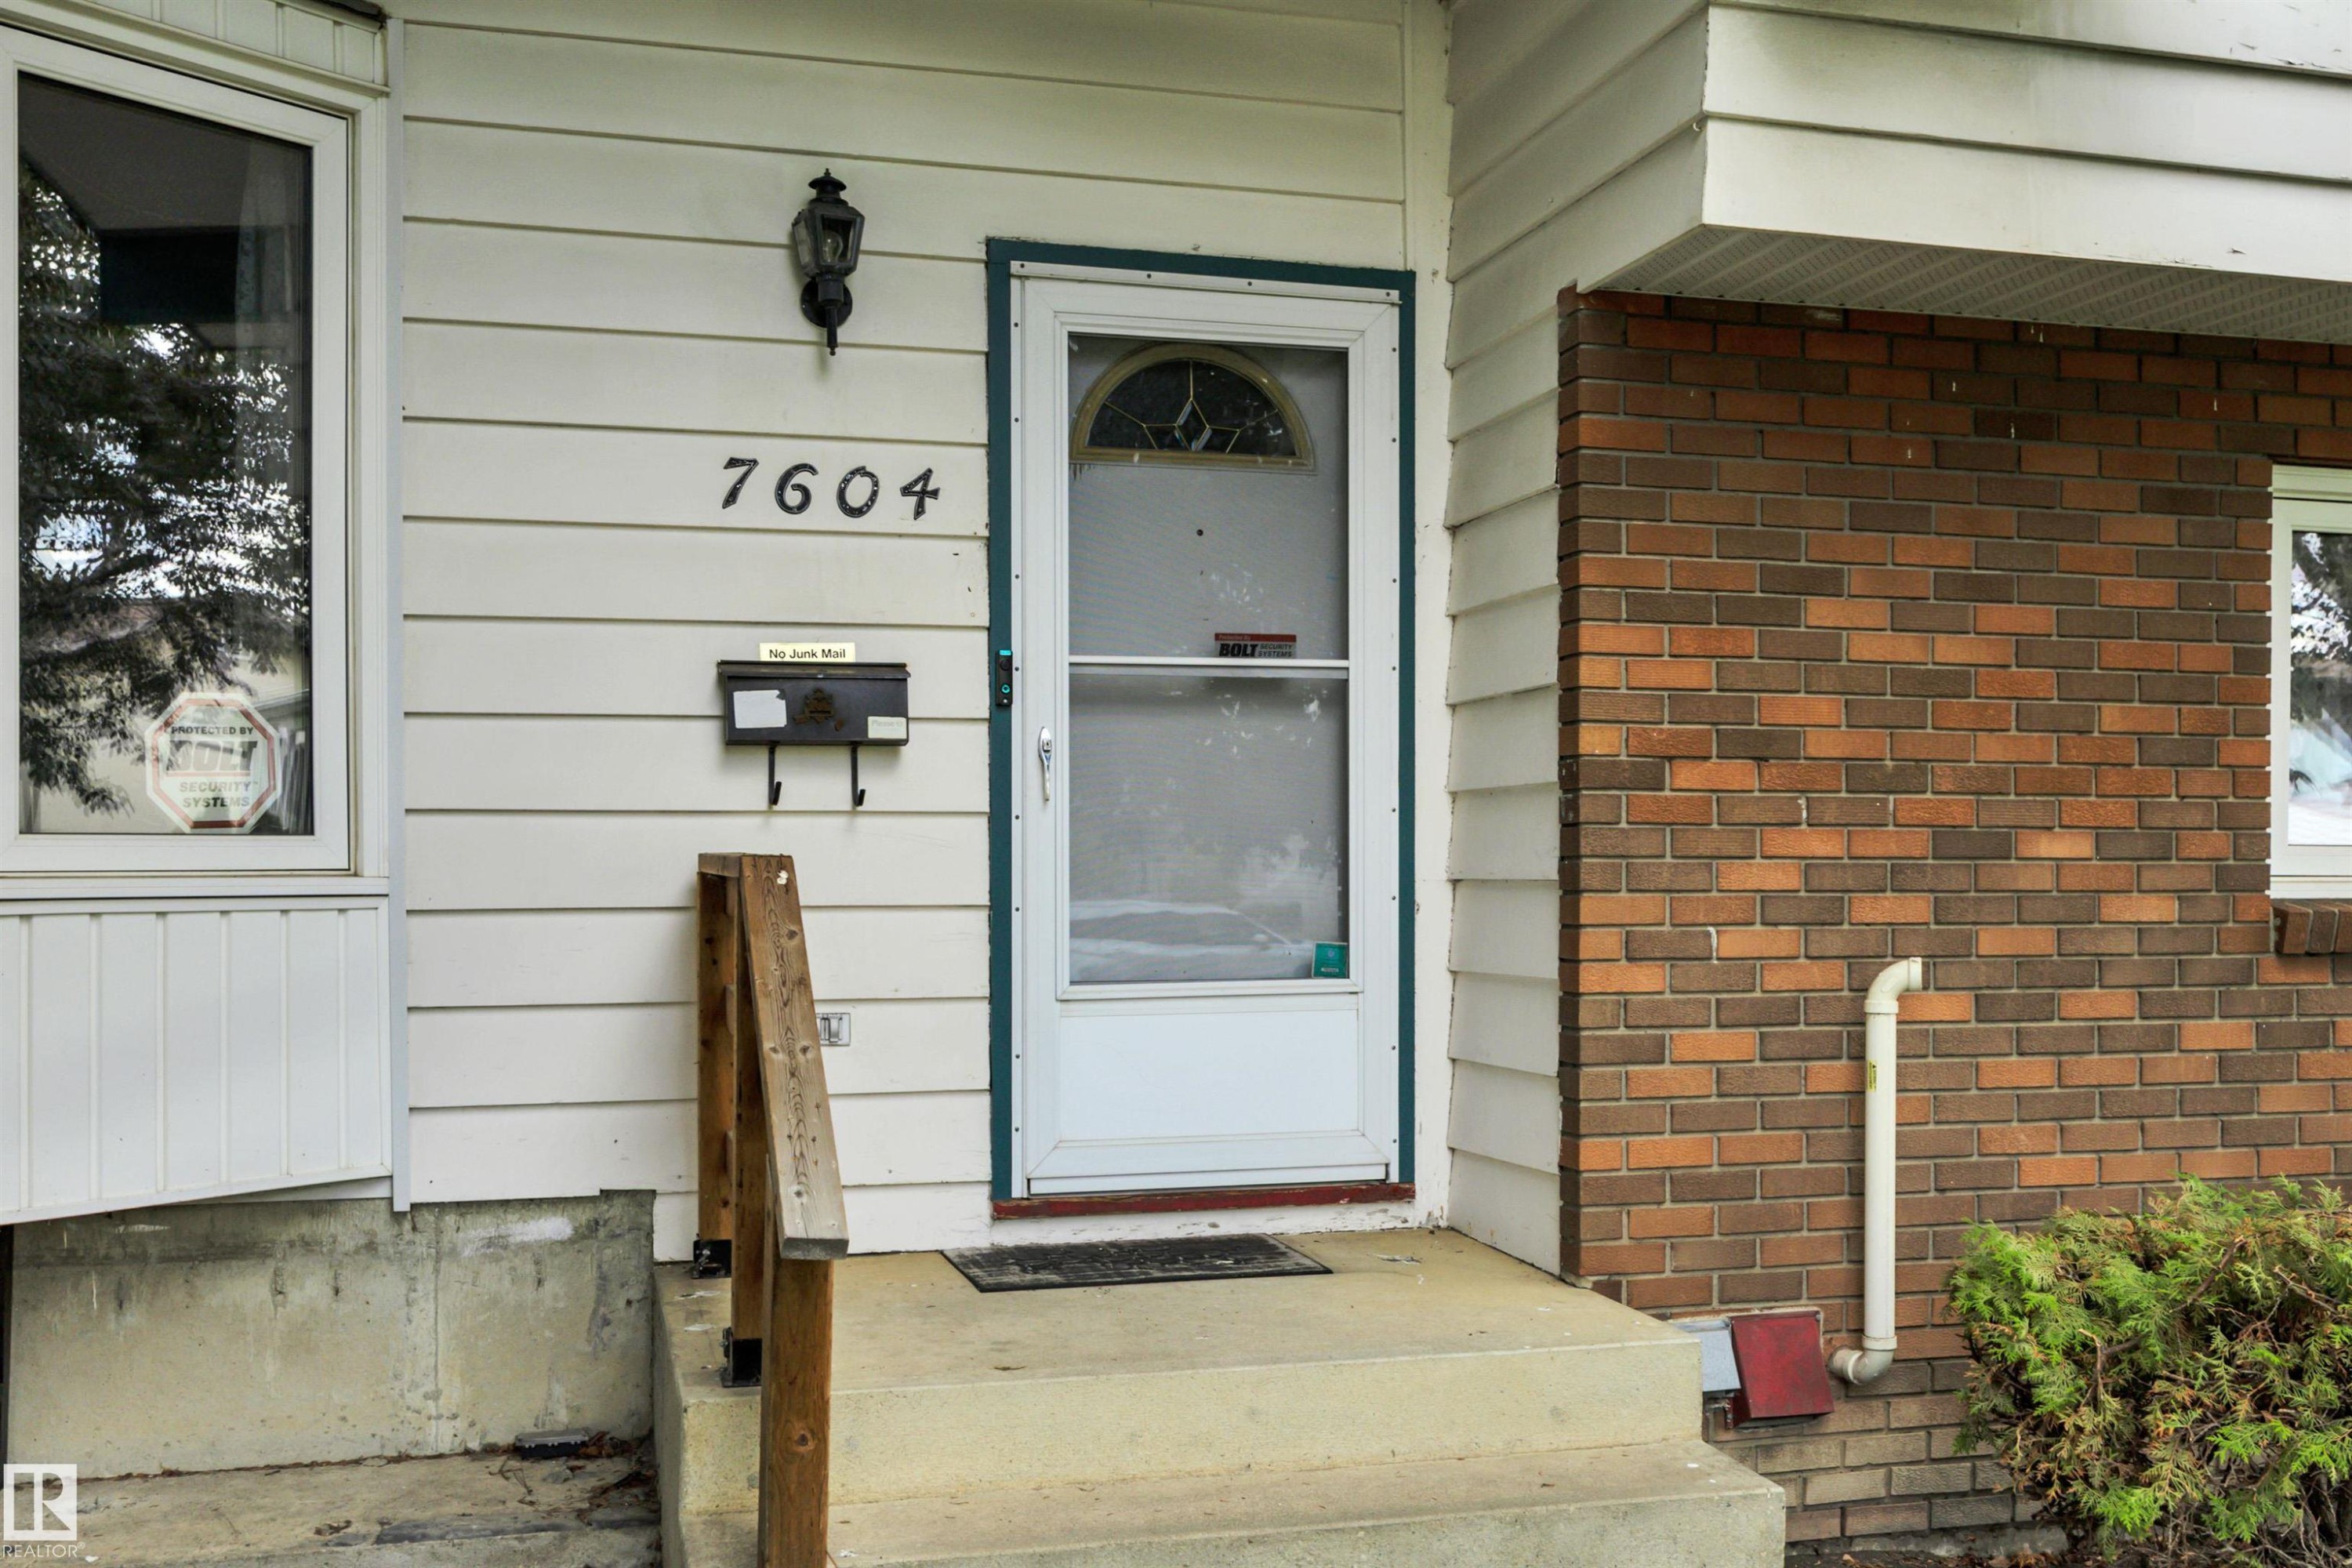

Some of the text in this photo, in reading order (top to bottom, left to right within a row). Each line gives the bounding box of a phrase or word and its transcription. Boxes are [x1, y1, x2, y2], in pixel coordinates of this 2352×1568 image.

[722, 456, 941, 521] 7604
[769, 648, 846, 659] No Junk Mail
[1219, 644, 1258, 657] BOLT
[171, 726, 254, 735] PROTECTED BY
[180, 782, 251, 793] SECURITY
[183, 797, 250, 808] SYSTEMS
